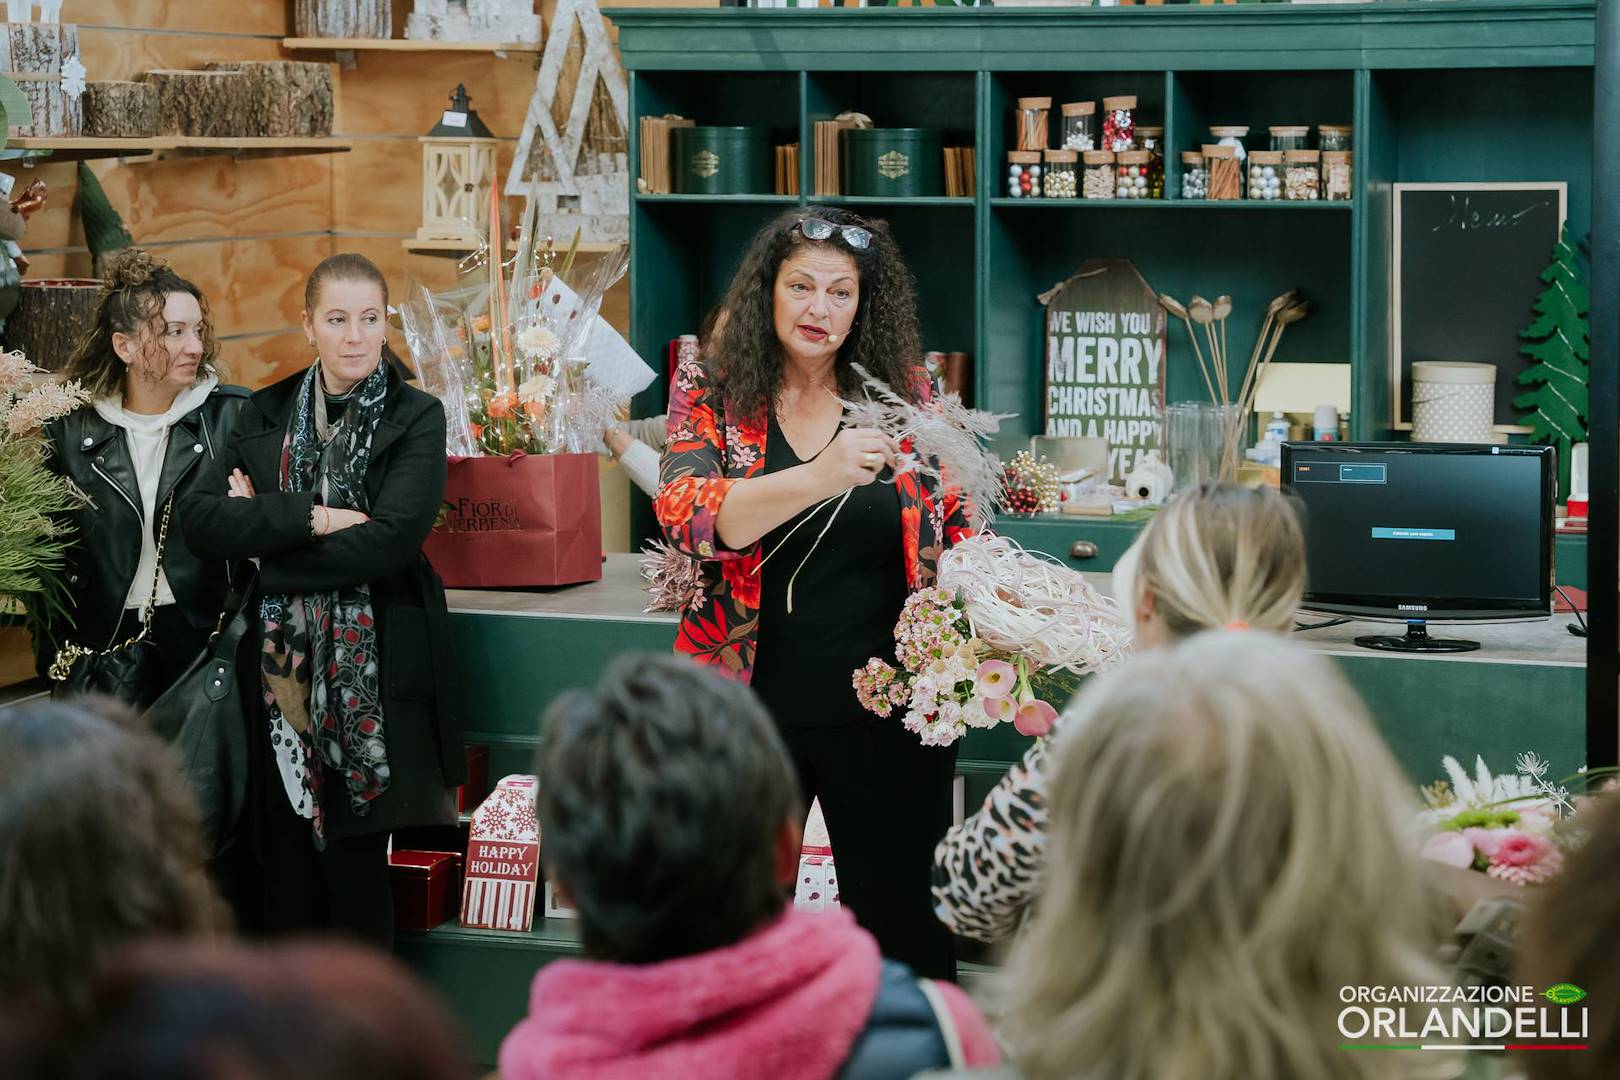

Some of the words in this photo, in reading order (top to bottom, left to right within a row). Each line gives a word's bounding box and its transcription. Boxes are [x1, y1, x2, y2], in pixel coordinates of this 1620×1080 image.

[1076, 311, 1116, 334] WISH
[1120, 312, 1149, 335] YOU
[1048, 336, 1163, 385] MERRY
[1047, 385, 1162, 418] CHRISTMAS
[1047, 418, 1082, 438] AND
[1087, 419, 1098, 438] A
[1104, 419, 1162, 445] HAPPY
[458, 497, 501, 517] FIOR
[479, 845, 528, 860] HAPPY
[471, 860, 533, 876] HOLIDAY
